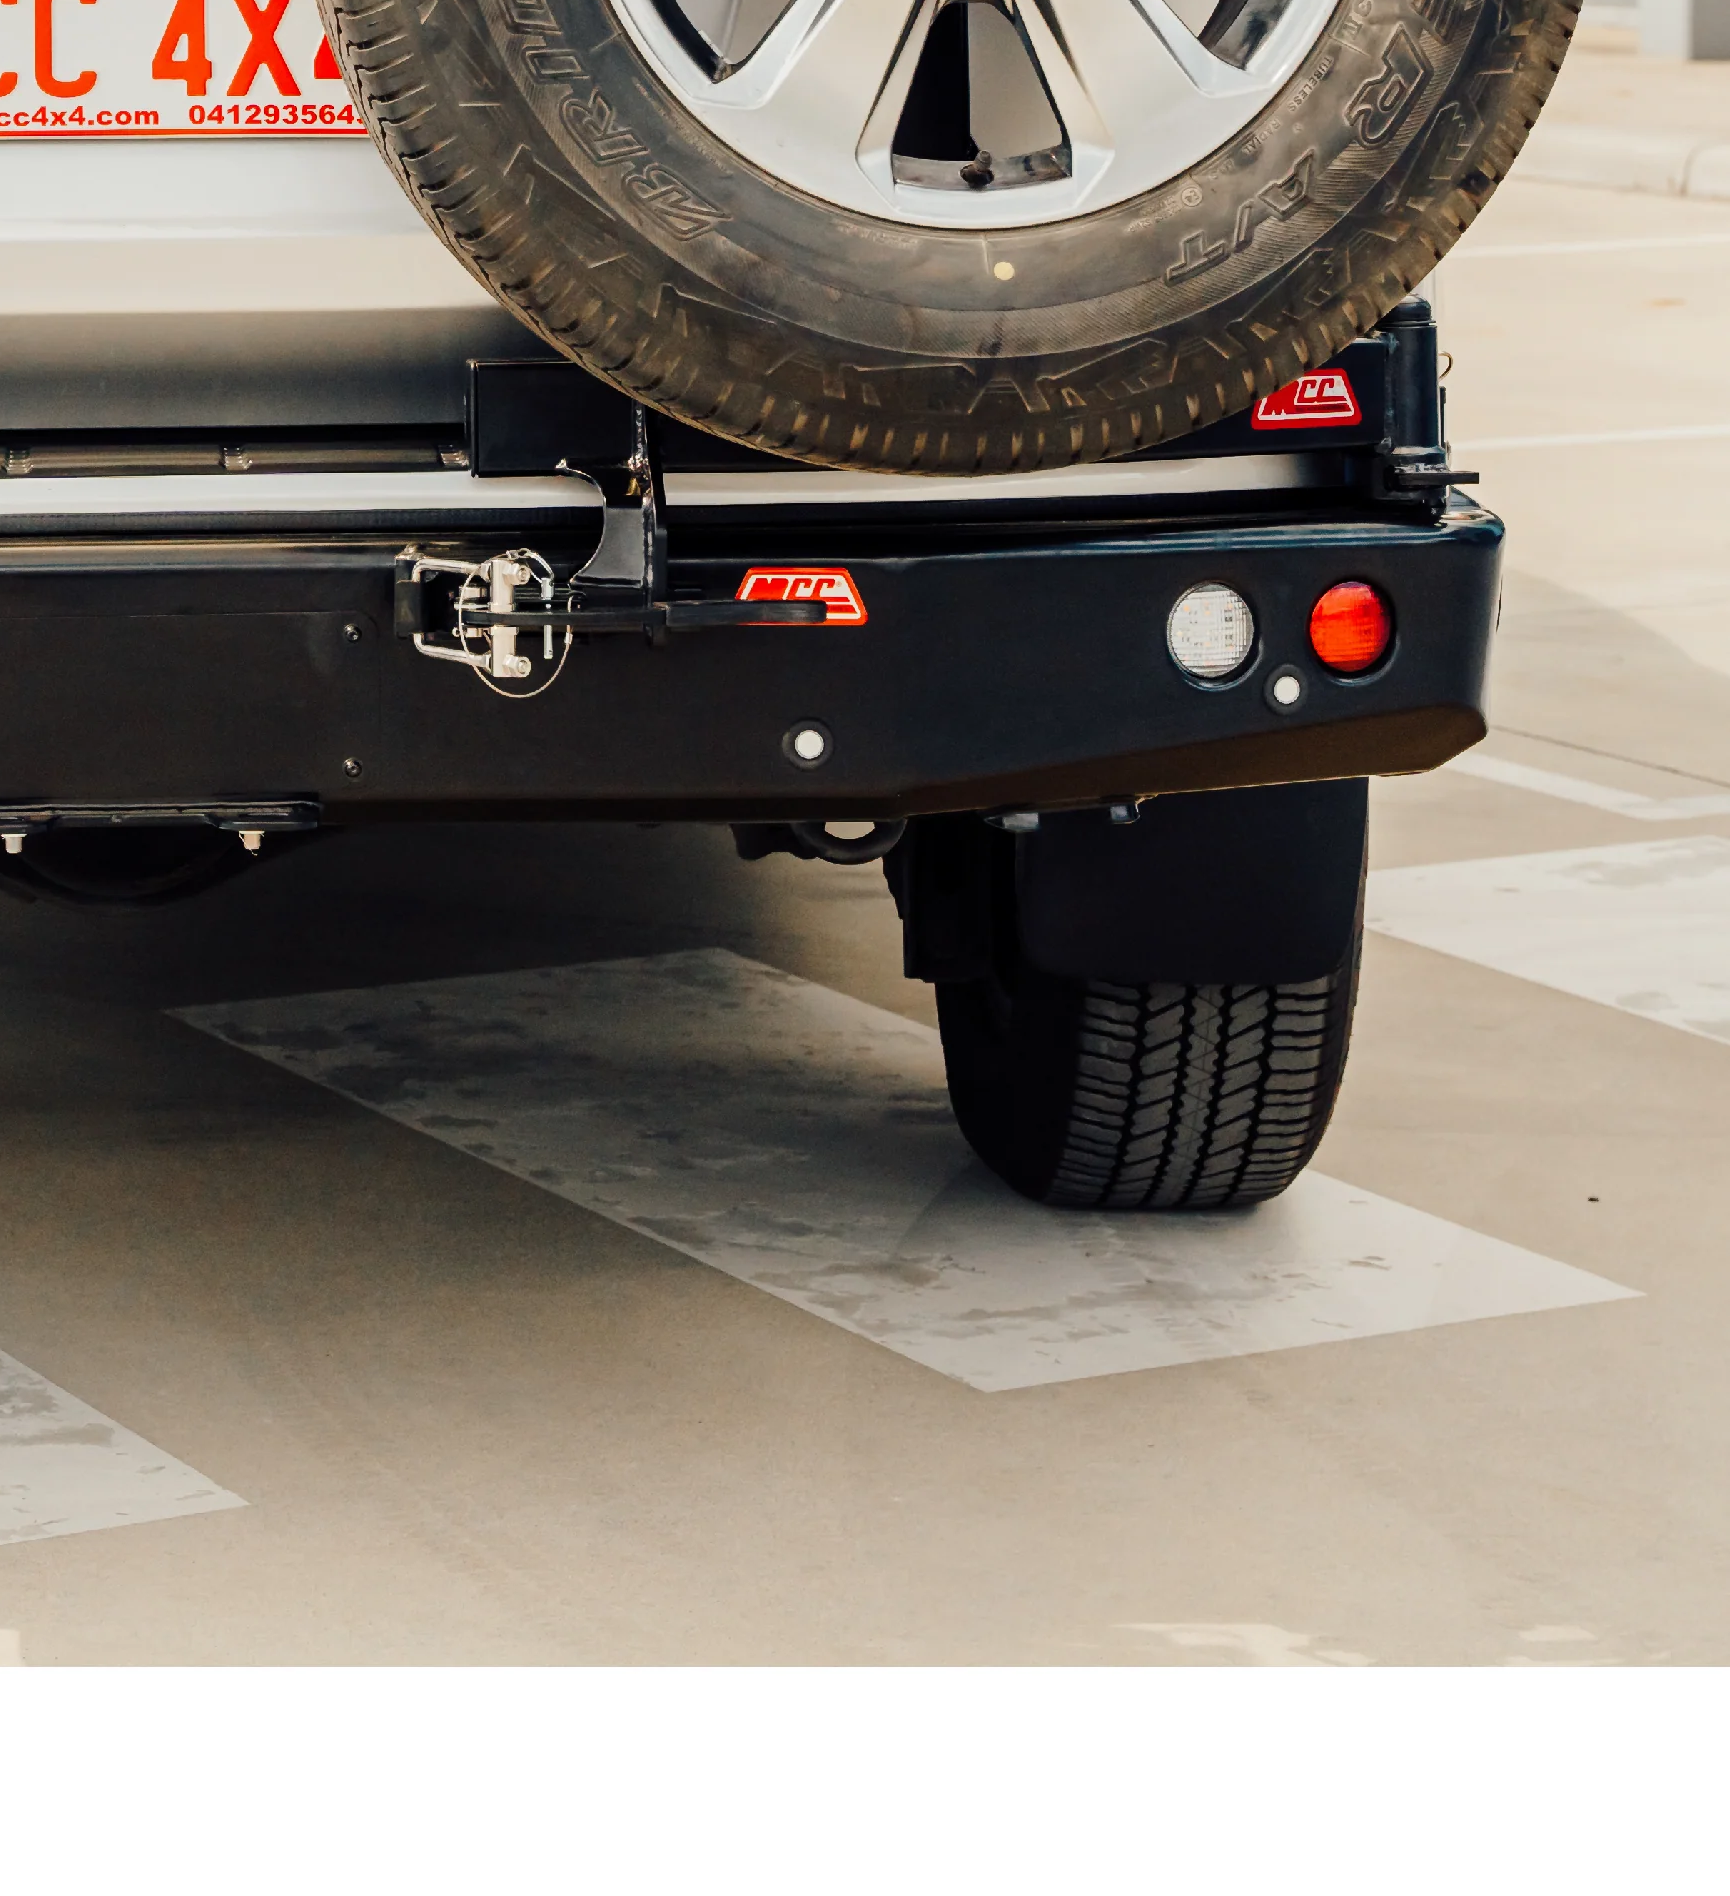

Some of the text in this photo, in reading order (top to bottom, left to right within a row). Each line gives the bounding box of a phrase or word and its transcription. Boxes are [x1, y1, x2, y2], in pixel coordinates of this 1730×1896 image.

[1286, 55, 1334, 112] TUBELESS
[188, 104, 363, 125] 041293564
[1167, 149, 1316, 283] A/T
